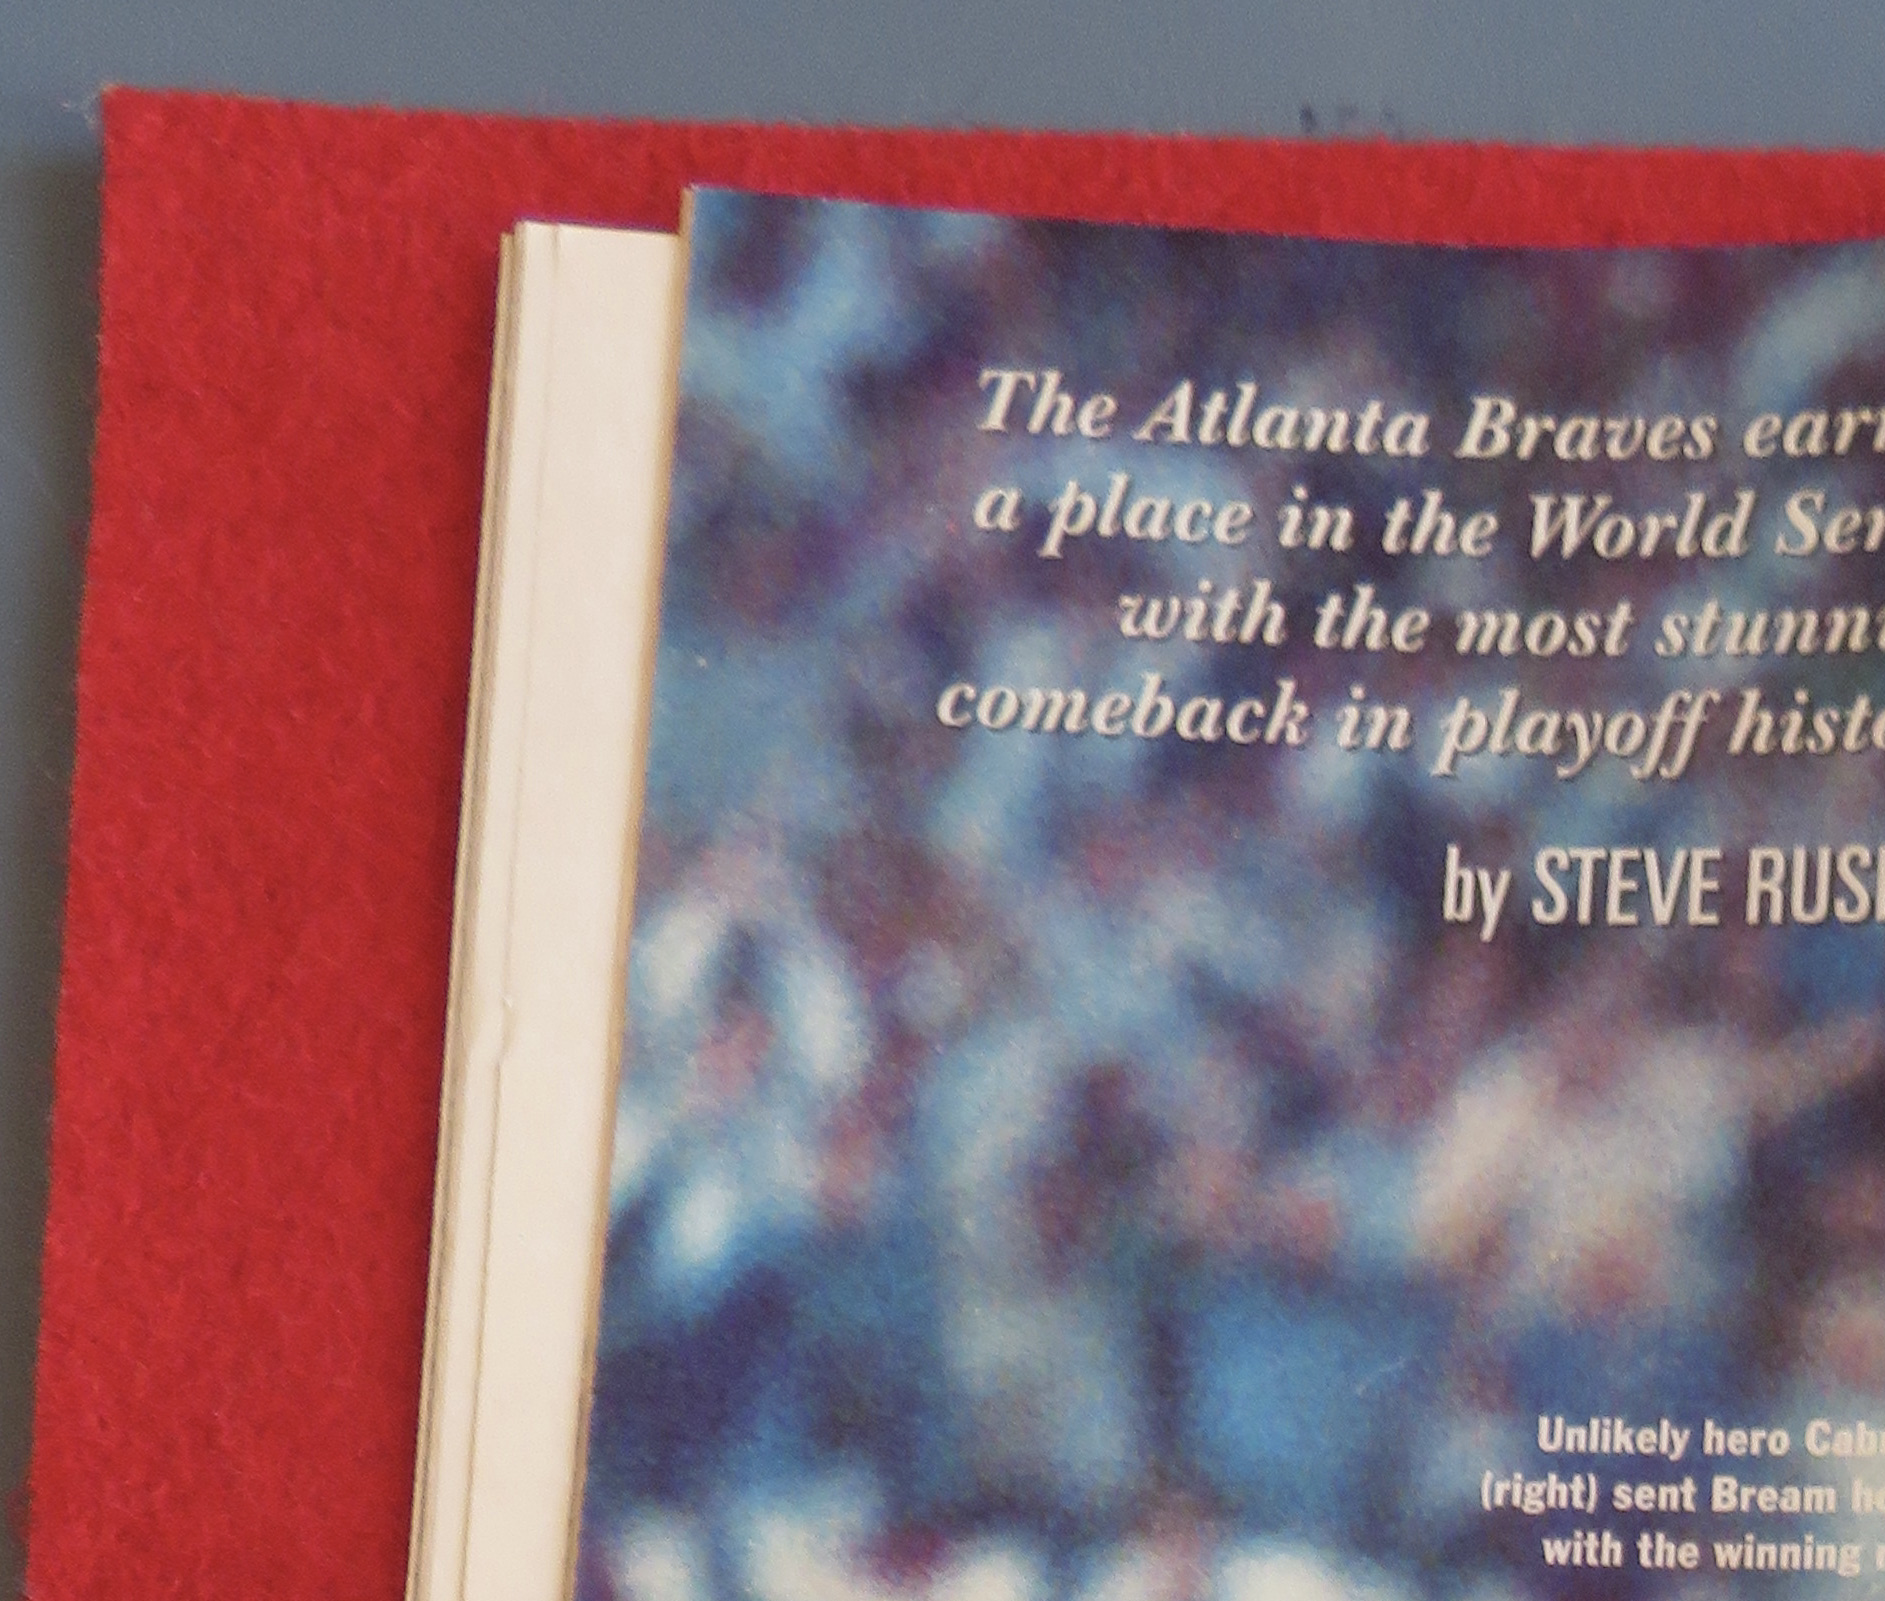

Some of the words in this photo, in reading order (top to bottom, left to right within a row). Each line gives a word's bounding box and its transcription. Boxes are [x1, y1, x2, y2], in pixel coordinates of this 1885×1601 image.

[977, 368, 1118, 443] The
[1135, 379, 1430, 458] Atlanta
[1455, 396, 1717, 464] Braves
[973, 485, 1020, 532] a
[1039, 471, 1253, 558] place
[1277, 485, 1354, 552] in
[1381, 488, 1500, 557] the
[1529, 489, 1754, 560] World
[1119, 580, 1286, 647] with
[1314, 584, 1430, 654] the
[1453, 599, 1637, 658] most
[936, 672, 1311, 749] comeback
[1335, 683, 1414, 751] in
[1430, 688, 1722, 781] playoff
[1442, 844, 1512, 942] by
[1532, 846, 1722, 928] STEVE
[1537, 1415, 1692, 1462] Unlikely
[1703, 1418, 1791, 1458] hero
[1480, 1470, 1599, 1516] (right)
[1612, 1476, 1697, 1513] sent
[1711, 1475, 1836, 1514] Bream
[1542, 1531, 1623, 1570] with
[1637, 1531, 1701, 1570] the
[1713, 1534, 1861, 1577] winning
